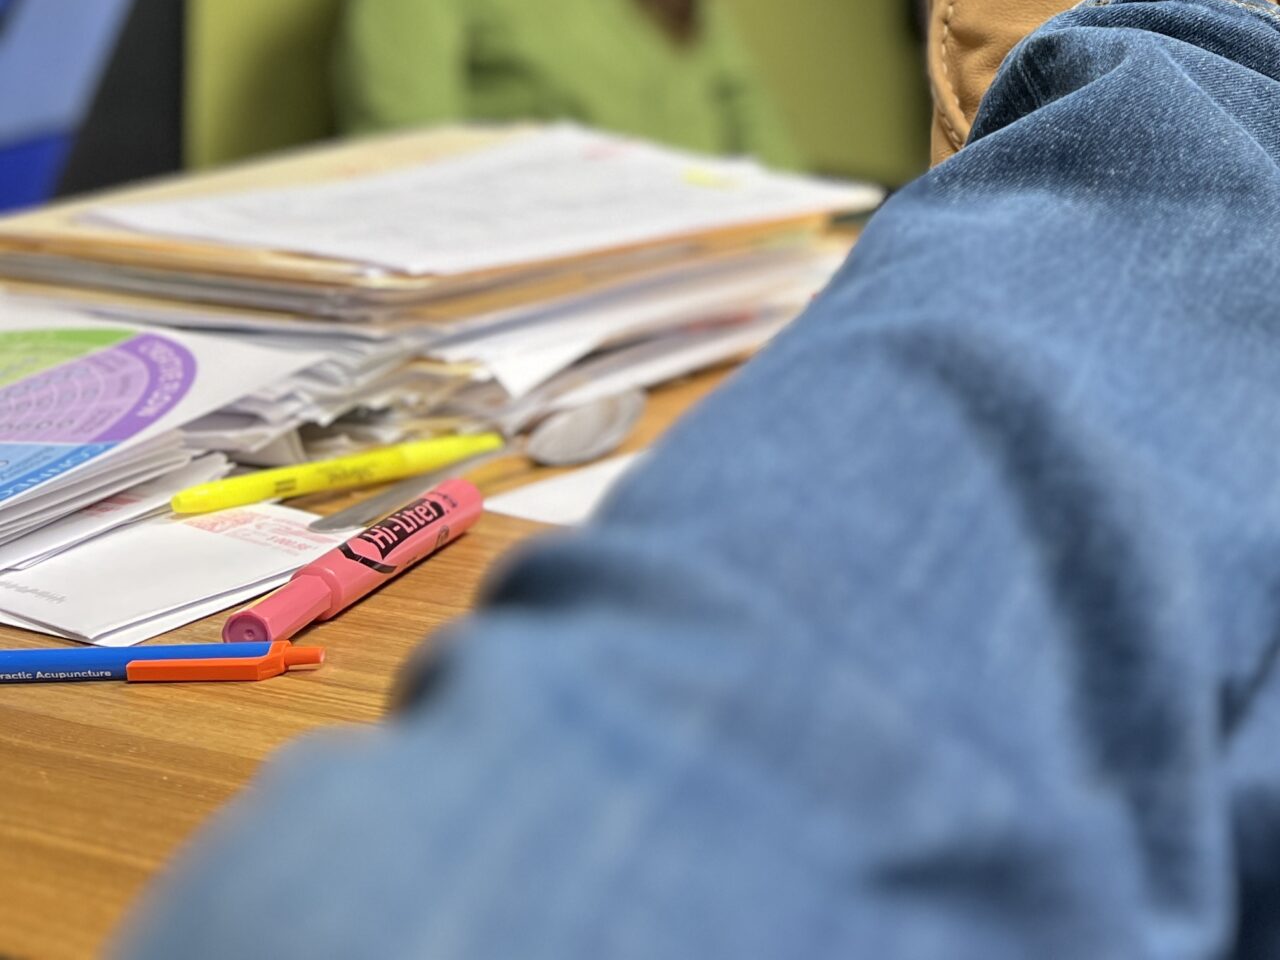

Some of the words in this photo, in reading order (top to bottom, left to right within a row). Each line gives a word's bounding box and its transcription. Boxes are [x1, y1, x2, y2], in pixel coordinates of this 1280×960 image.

[363, 500, 438, 549] Hi-Liter
[0, 671, 33, 680] ractic
[36, 670, 112, 680] Acupuncture
